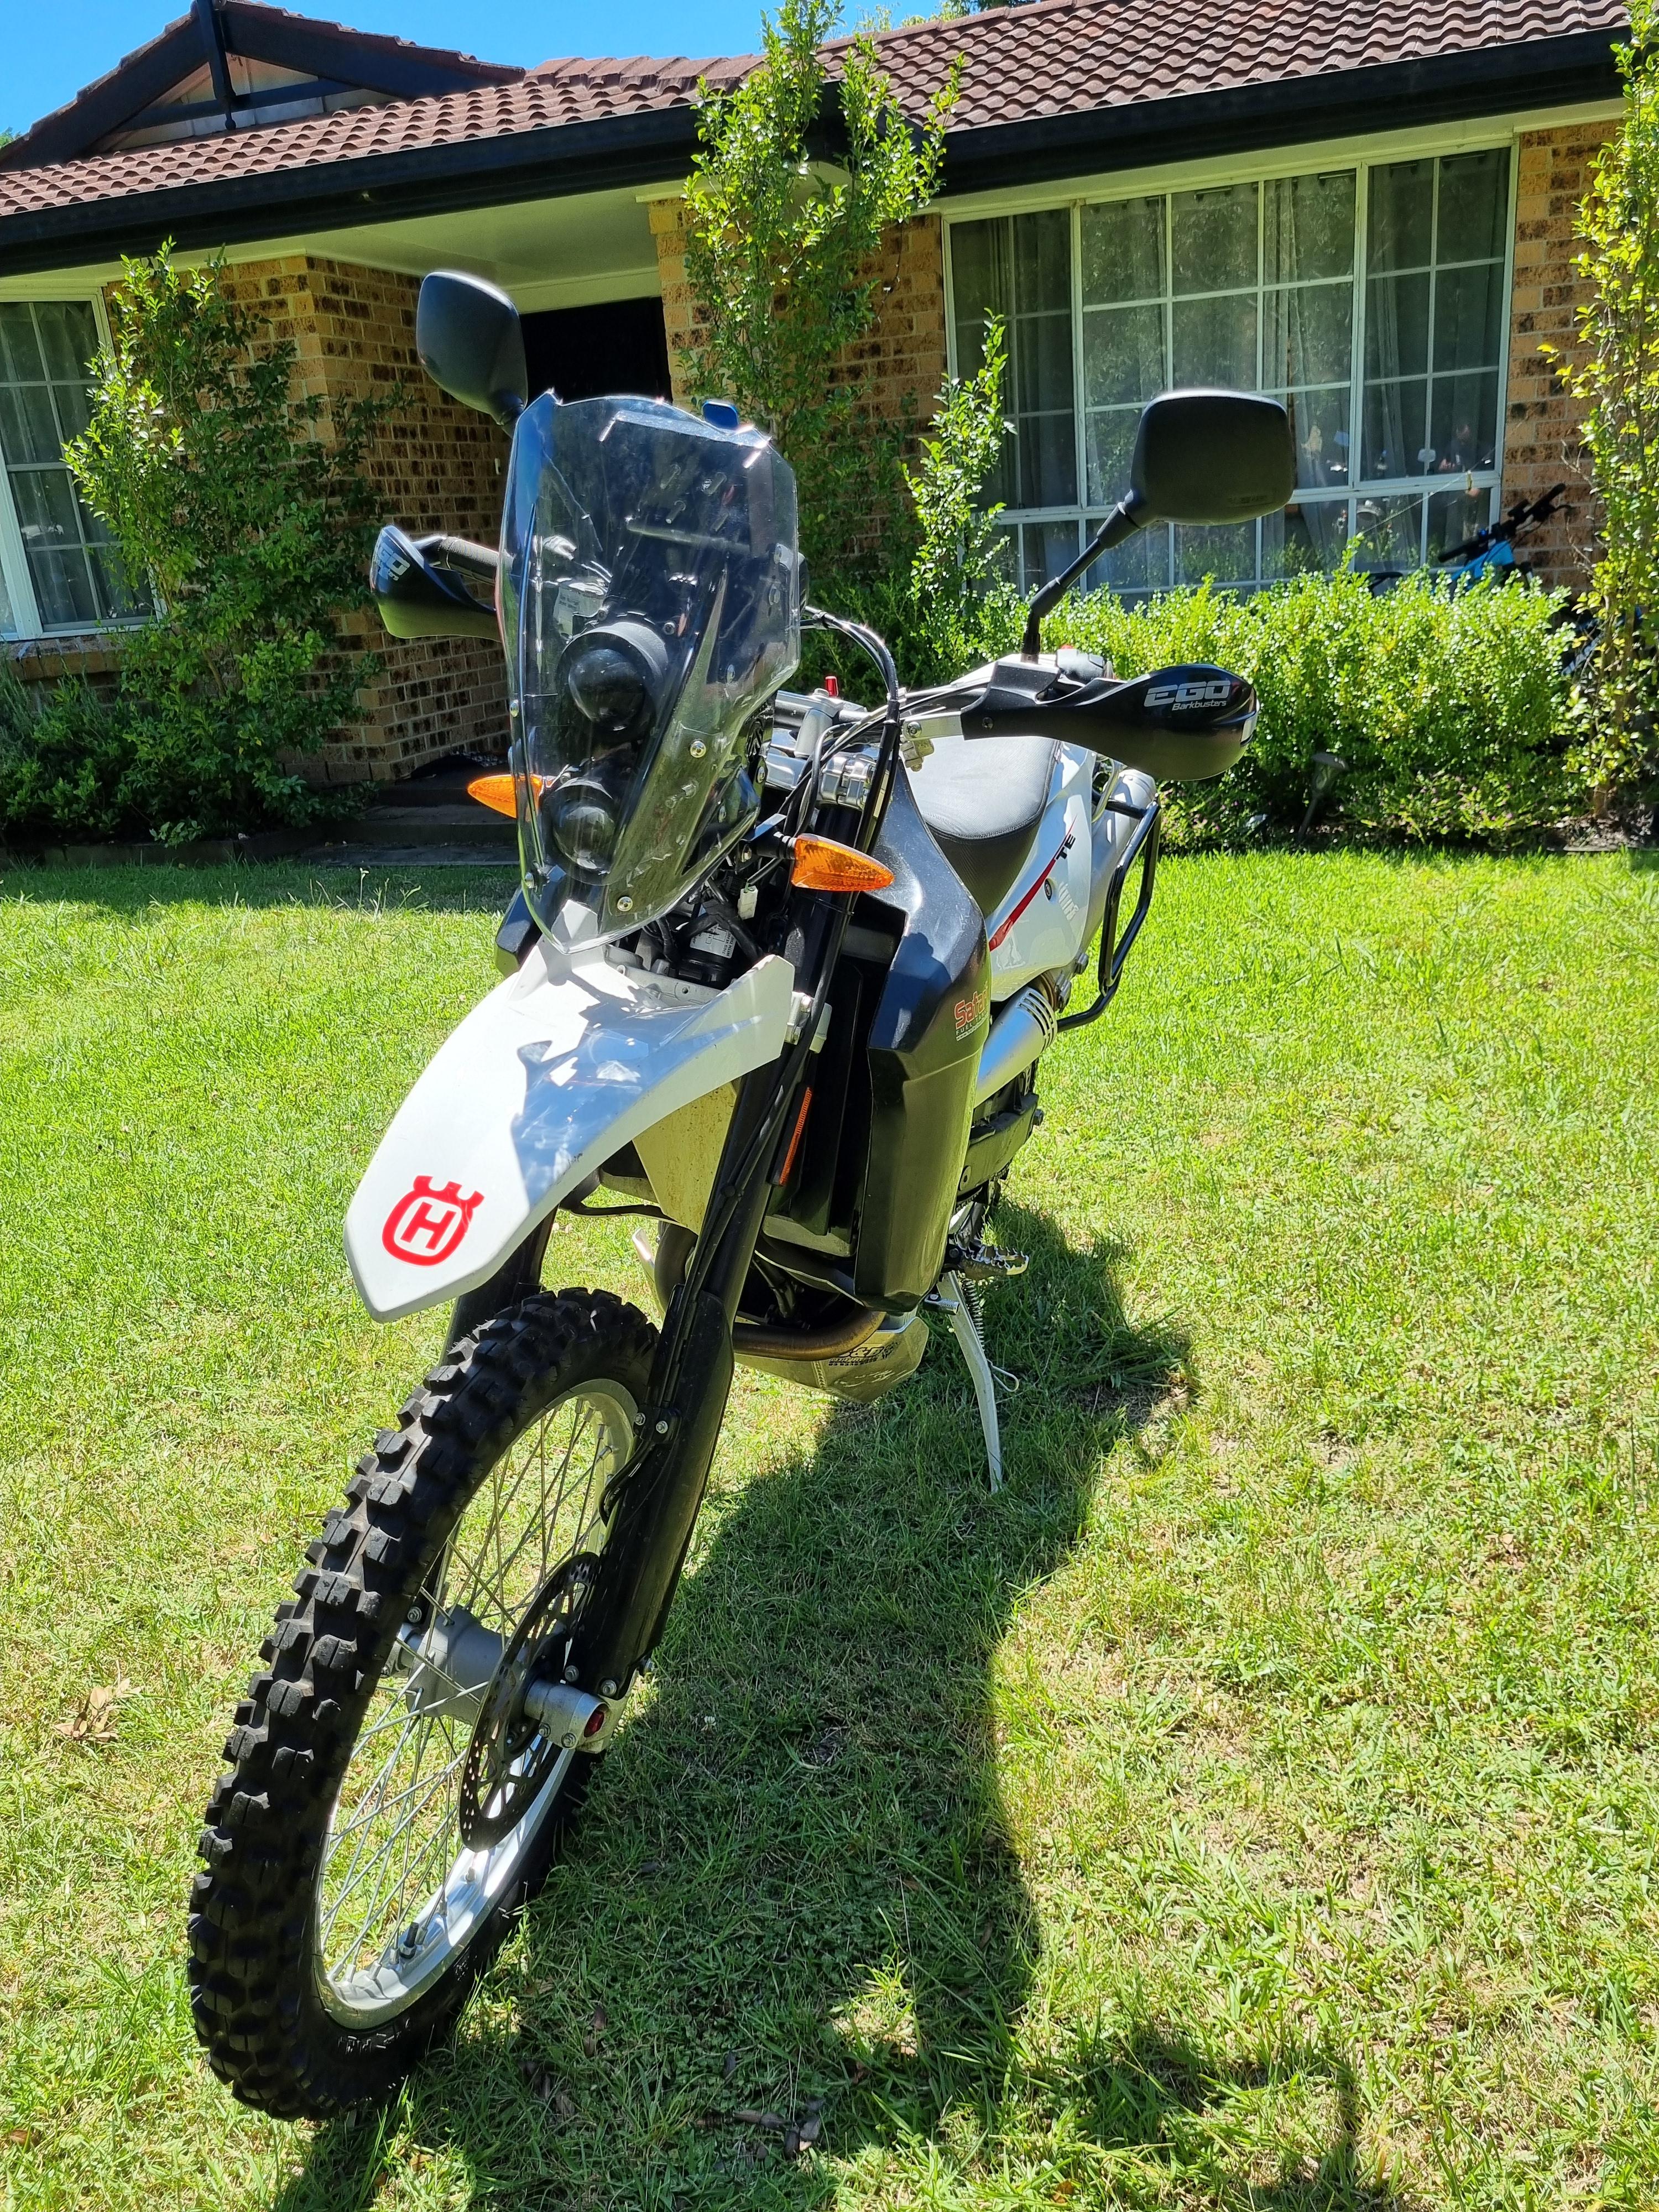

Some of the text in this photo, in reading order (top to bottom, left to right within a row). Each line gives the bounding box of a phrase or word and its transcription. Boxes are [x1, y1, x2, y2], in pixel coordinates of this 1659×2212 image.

[1144, 680, 1231, 707] EGO
[1171, 700, 1227, 711] Barkbusters
[1056, 833, 1076, 860] TE
[956, 1022, 973, 1036] FUEL
